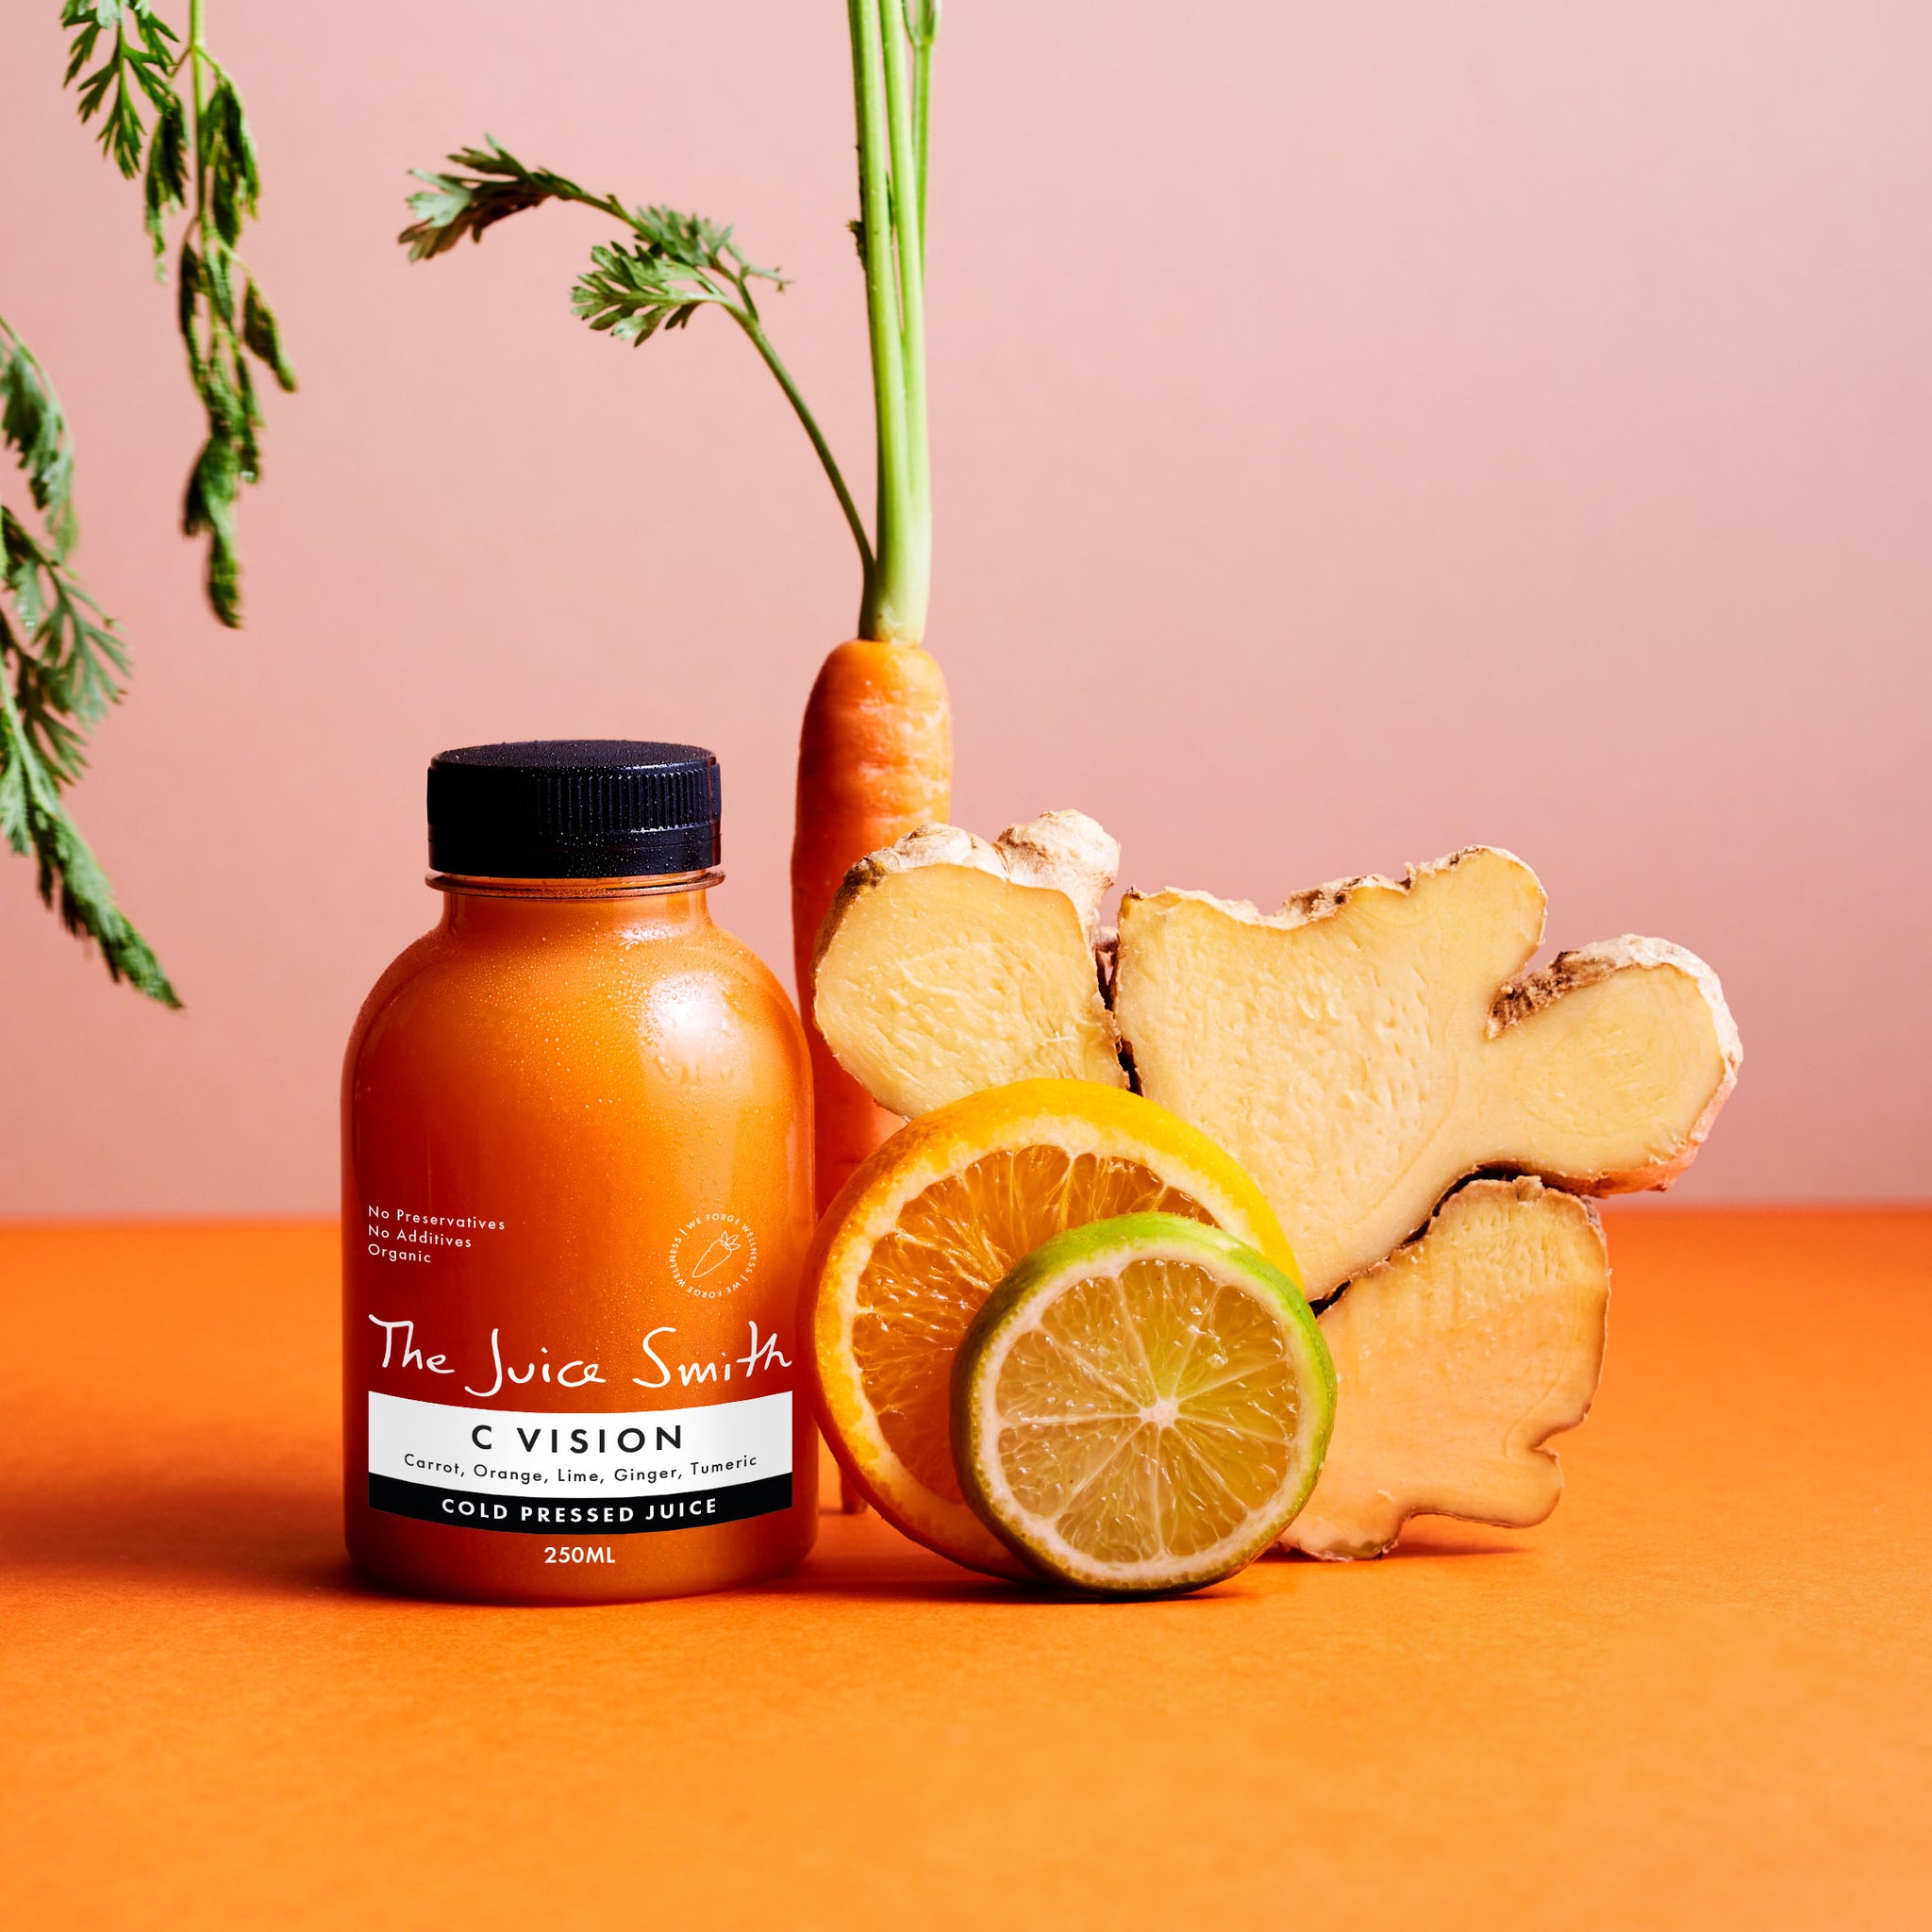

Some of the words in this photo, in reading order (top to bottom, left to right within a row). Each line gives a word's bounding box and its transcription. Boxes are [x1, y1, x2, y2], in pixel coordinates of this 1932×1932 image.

[369, 1206, 390, 1219] No
[397, 1208, 505, 1230] Preservatives
[369, 1224, 390, 1239] No
[396, 1228, 472, 1248] Additives
[686, 1217, 702, 1229] WE
[706, 1213, 741, 1225] FORGE
[741, 1224, 757, 1274] WELLNESS
[369, 1243, 432, 1263] Organic
[669, 1237, 686, 1288] WELLNESS
[687, 1285, 722, 1299] FORGE
[725, 1282, 741, 1293] WE
[368, 1314, 455, 1374] The
[465, 1328, 607, 1397] Juice
[632, 1321, 792, 1389] Smith
[472, 1424, 492, 1450] C
[517, 1424, 682, 1454] VISION
[404, 1453, 465, 1476] Carrot,
[474, 1464, 548, 1485] Orange,
[558, 1468, 605, 1485] Lime,
[614, 1466, 682, 1485] Ginger,
[691, 1455, 758, 1476] Tumeric
[441, 1498, 508, 1520] COLD
[521, 1507, 634, 1523] PRESSED
[645, 1498, 717, 1521] JUICE
[543, 1546, 616, 1564] 250ML
